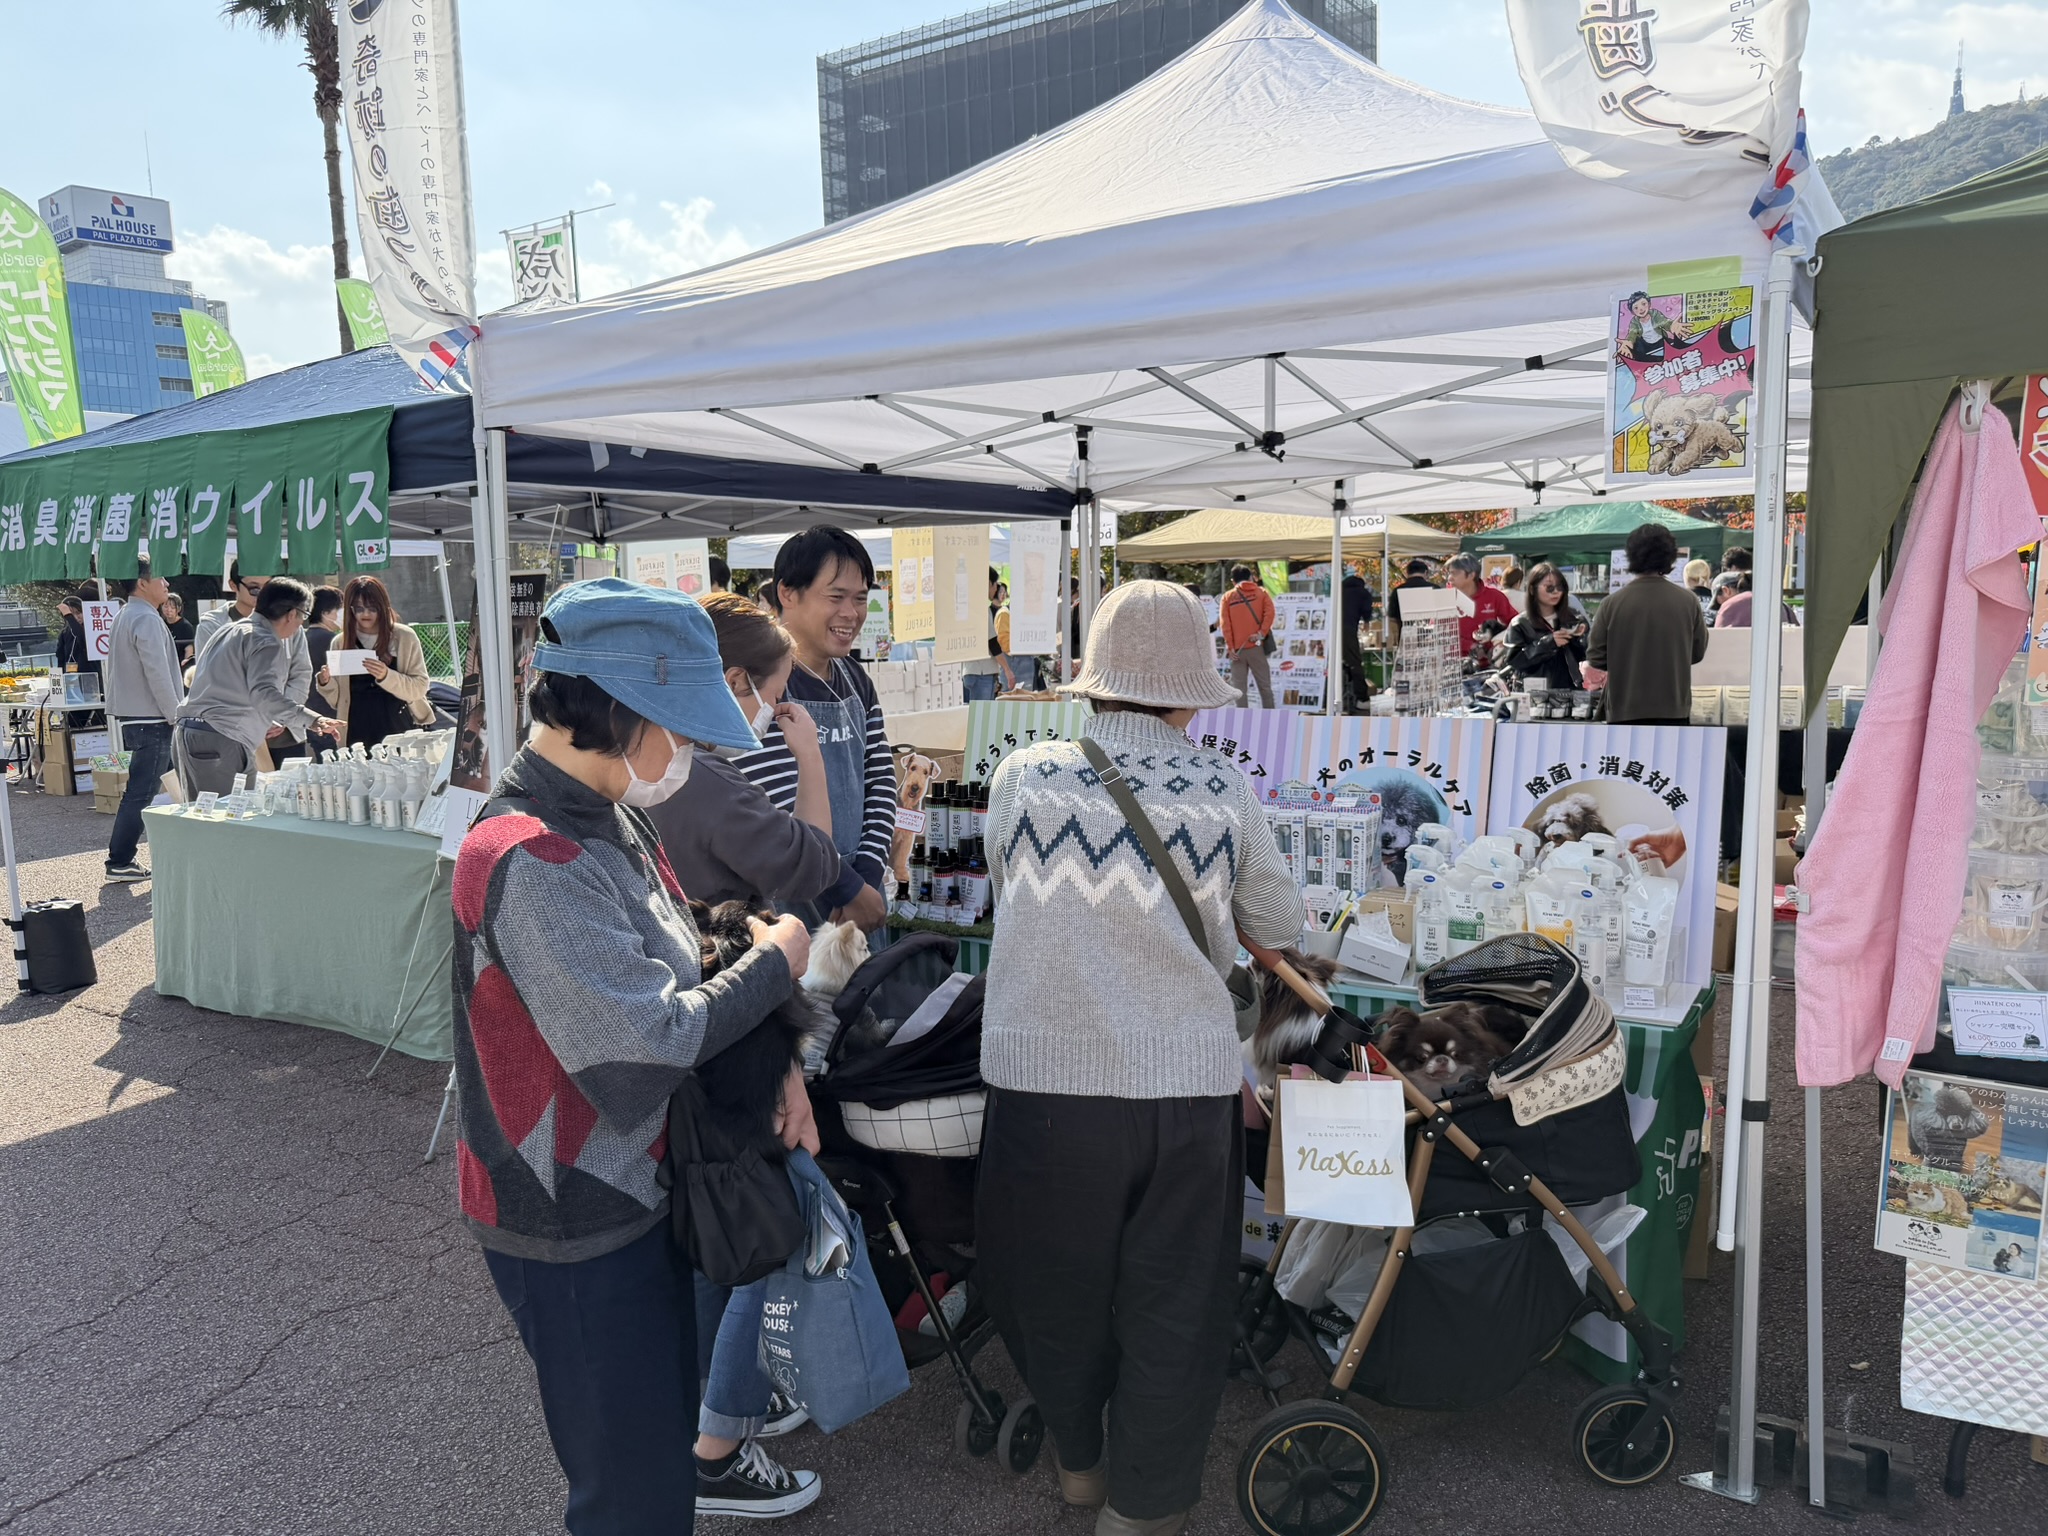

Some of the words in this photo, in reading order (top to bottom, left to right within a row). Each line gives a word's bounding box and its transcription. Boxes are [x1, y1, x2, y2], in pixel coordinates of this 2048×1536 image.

[91, 215, 115, 230] PAL
[116, 219, 157, 236] HOUSE
[92, 231, 108, 240] PAL
[110, 233, 136, 244] PLAZA
[1644, 349, 1703, 386] 参加者
[1679, 355, 1747, 394] 募集中!
[0, 470, 383, 551] 消臭消菌消ウイルス
[1525, 755, 1690, 813] 除菌・消臭対策
[763, 1317, 790, 1333] OUSE
